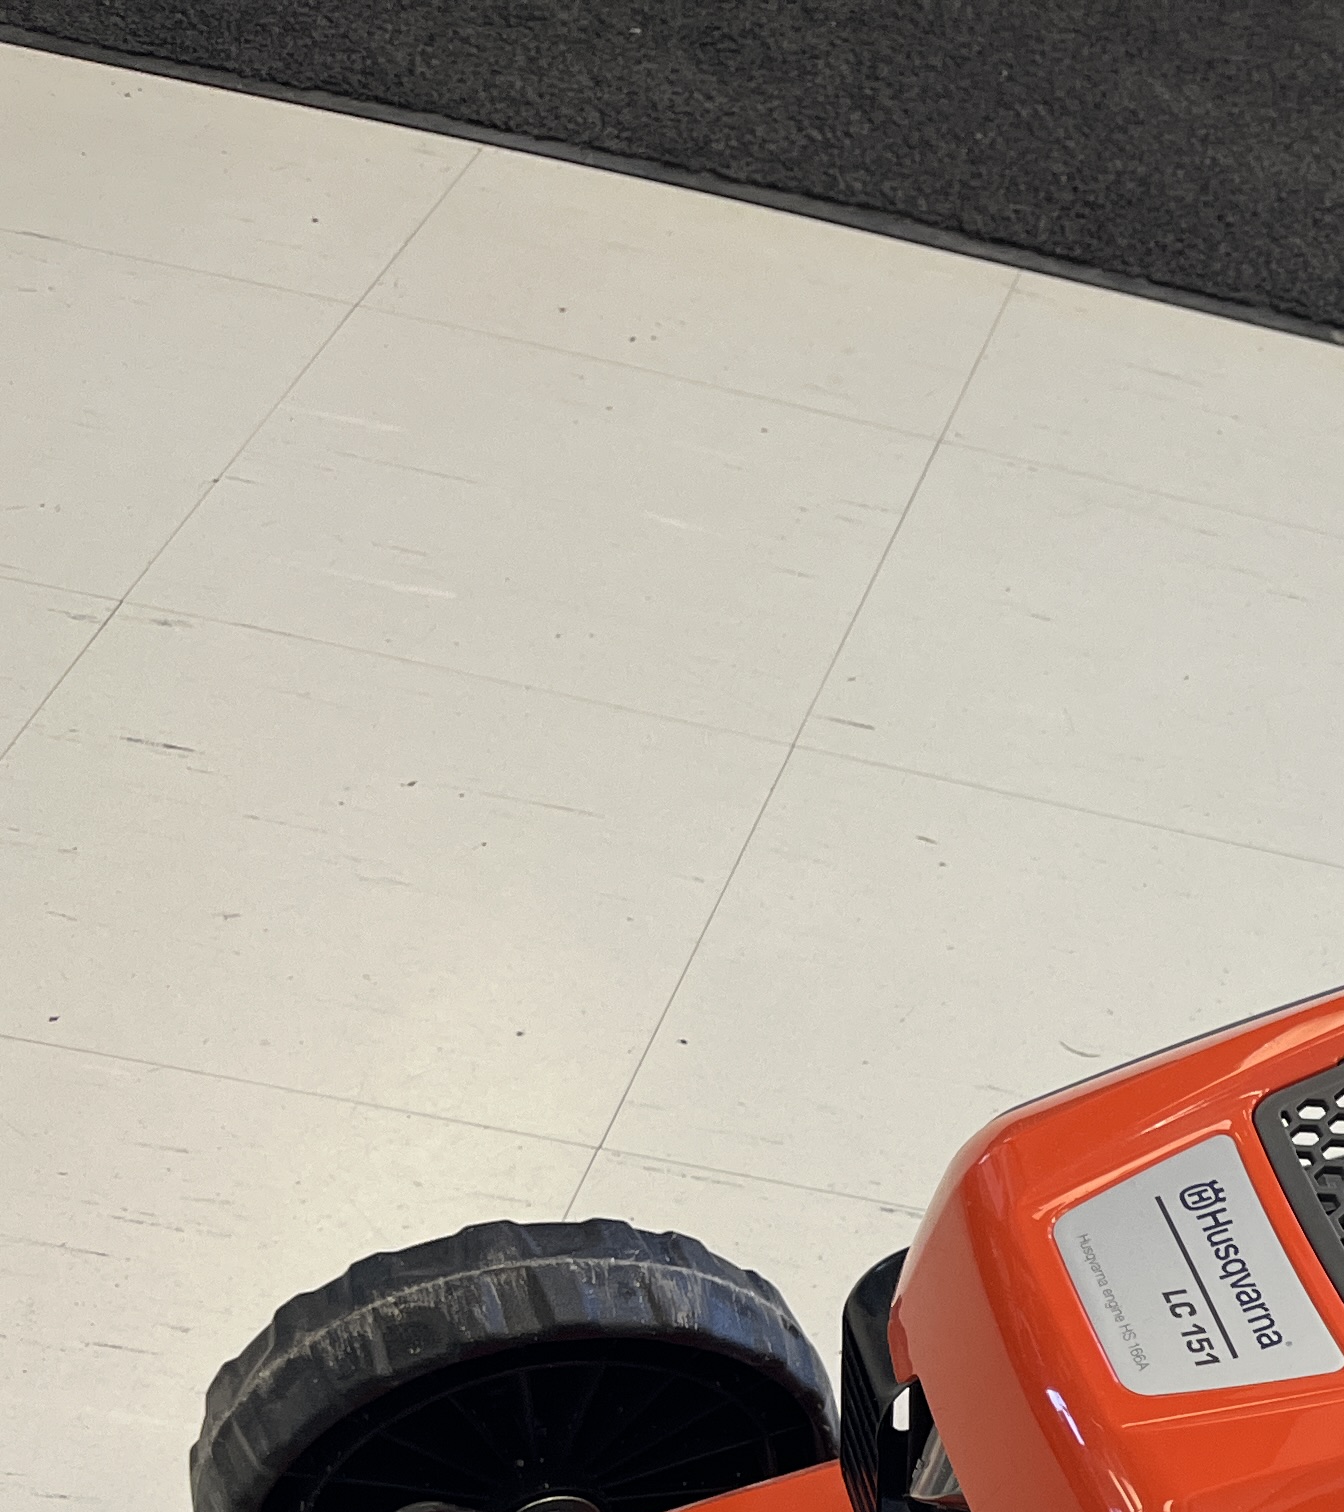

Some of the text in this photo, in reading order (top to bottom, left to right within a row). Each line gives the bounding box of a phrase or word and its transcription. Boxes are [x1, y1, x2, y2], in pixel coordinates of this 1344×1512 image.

[1077, 1233, 1150, 1372] Husqvarna engine HS 166A
[1161, 1289, 1220, 1366] LC 151
[1196, 1207, 1282, 1350] Husqvarna
